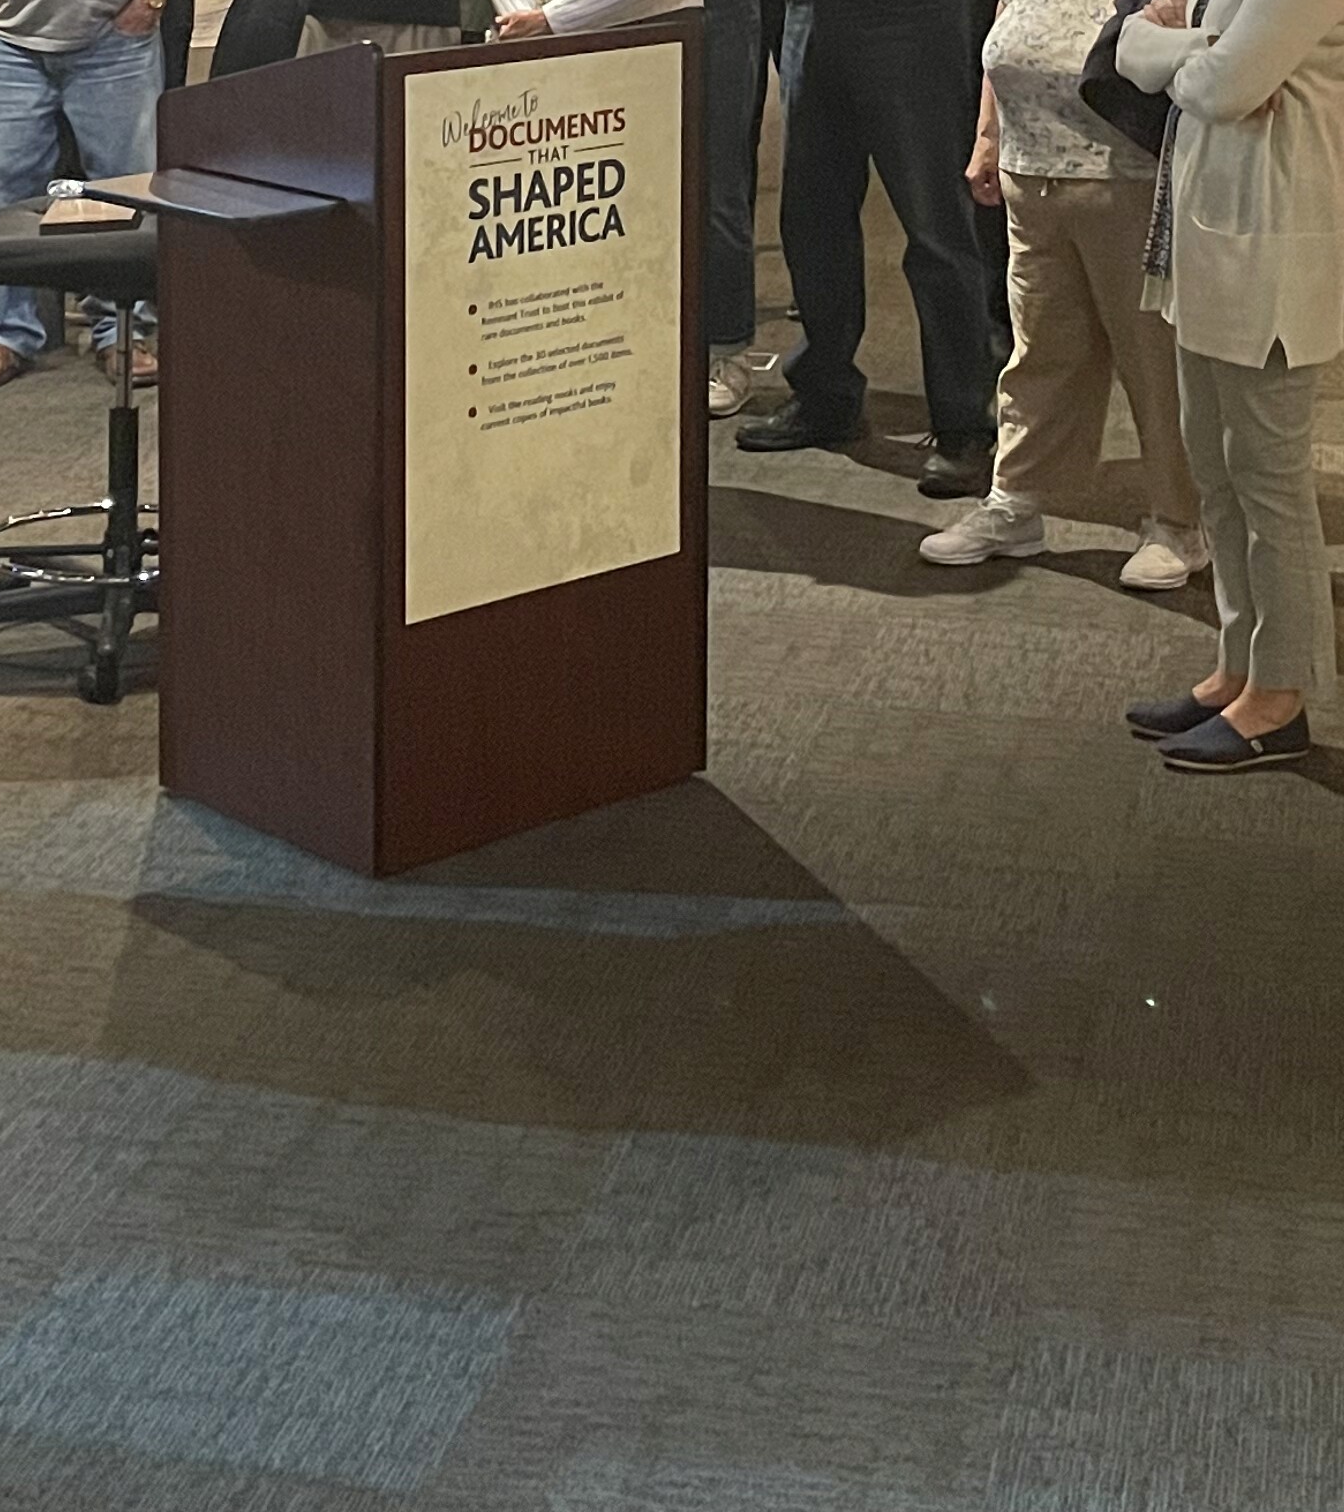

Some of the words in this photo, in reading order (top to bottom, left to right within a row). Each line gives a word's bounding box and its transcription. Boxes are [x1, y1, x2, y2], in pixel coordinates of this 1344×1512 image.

[442, 98, 520, 147] Welcome
[469, 108, 626, 153] DOCUMENTS
[527, 145, 570, 165] THAT
[468, 159, 626, 220] SHAPED
[468, 203, 626, 264] AMERICA
